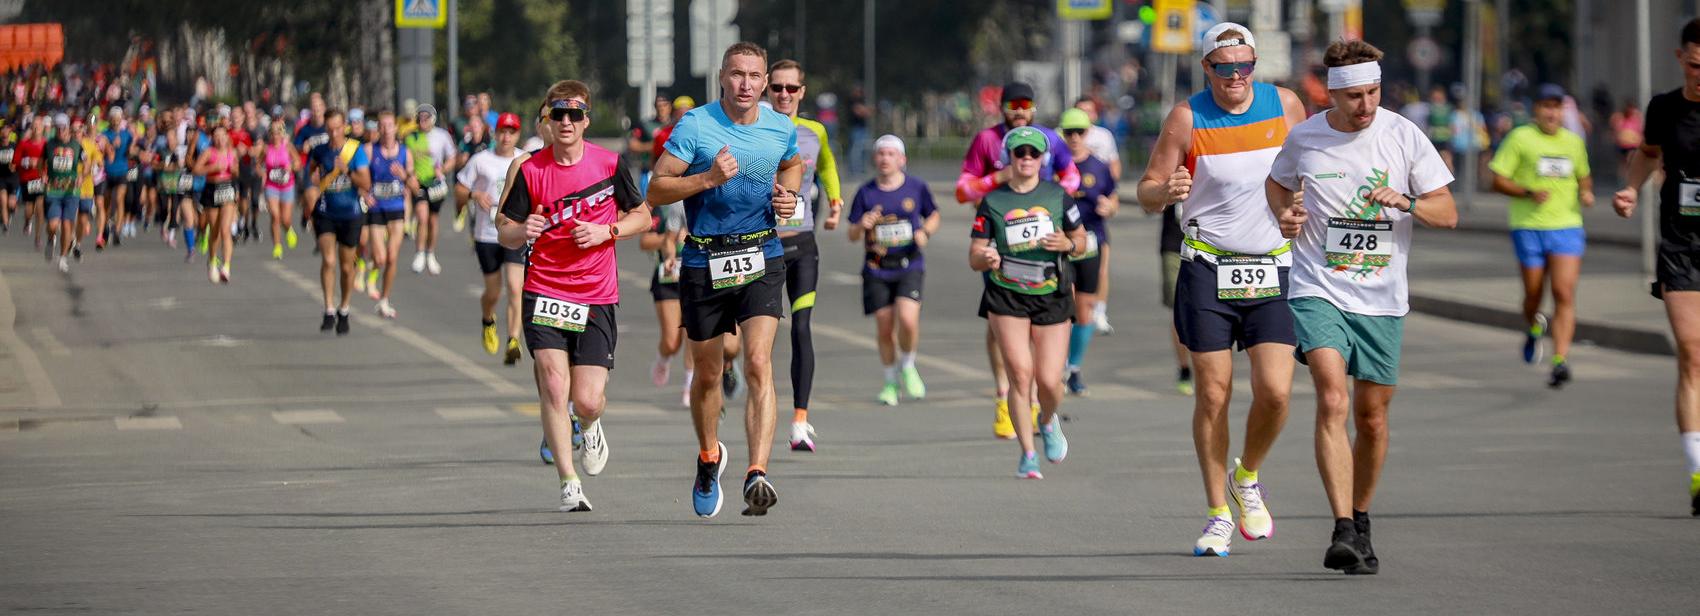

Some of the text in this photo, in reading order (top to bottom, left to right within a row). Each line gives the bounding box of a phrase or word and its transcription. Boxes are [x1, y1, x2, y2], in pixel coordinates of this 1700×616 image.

[1022, 226, 1038, 238] 67
[1339, 233, 1377, 250] 428
[722, 257, 753, 274] 413
[1231, 269, 1265, 285] 839
[540, 301, 581, 320] 1036
